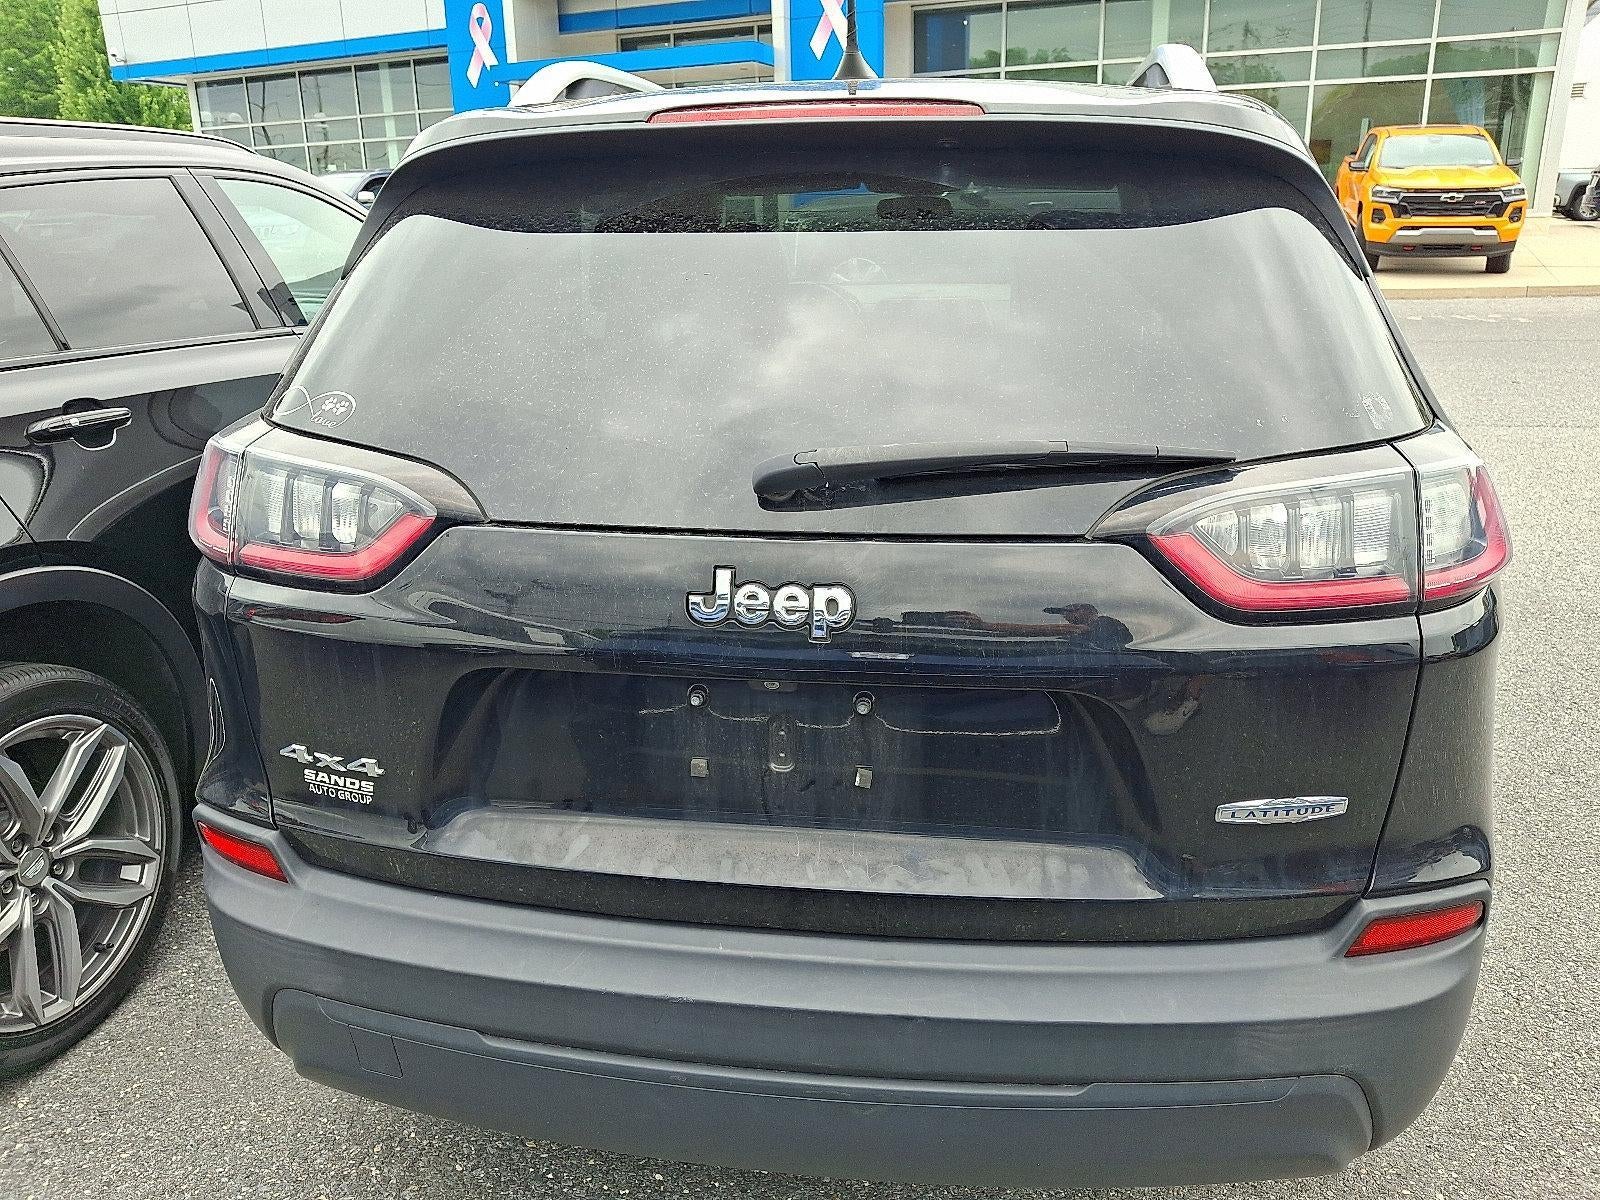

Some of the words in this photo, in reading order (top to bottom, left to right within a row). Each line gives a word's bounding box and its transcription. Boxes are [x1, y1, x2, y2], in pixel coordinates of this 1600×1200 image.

[310, 410, 337, 428] love
[687, 566, 855, 640] Jeep
[303, 768, 375, 791] SANDS
[309, 783, 336, 798] AUTO
[337, 790, 373, 805] GROUP
[1230, 804, 1336, 819] LATITUDE
